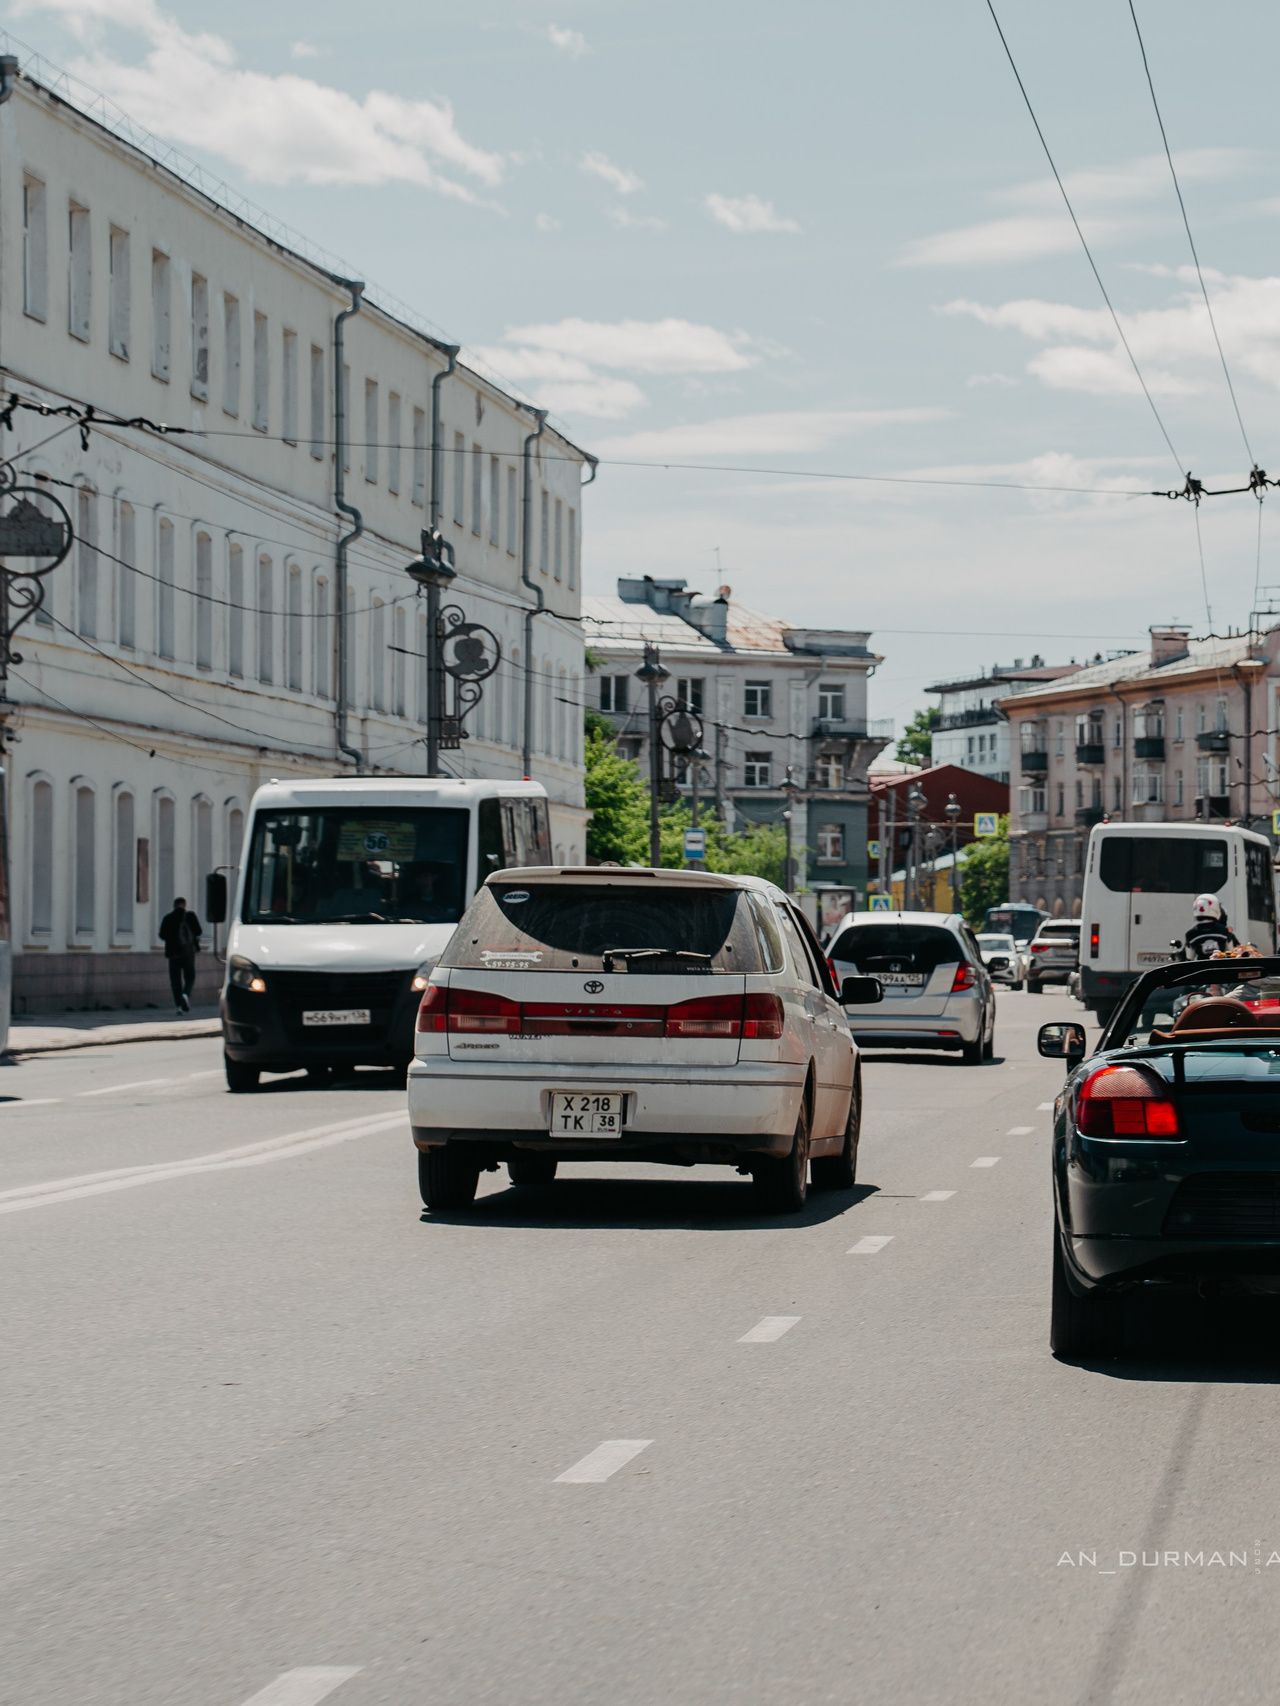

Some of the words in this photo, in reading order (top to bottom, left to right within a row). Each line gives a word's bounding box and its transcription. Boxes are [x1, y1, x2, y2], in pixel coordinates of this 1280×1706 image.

[366, 835, 388, 850] 56
[580, 1096, 611, 1112] 218
[599, 1115, 615, 1127] 38
